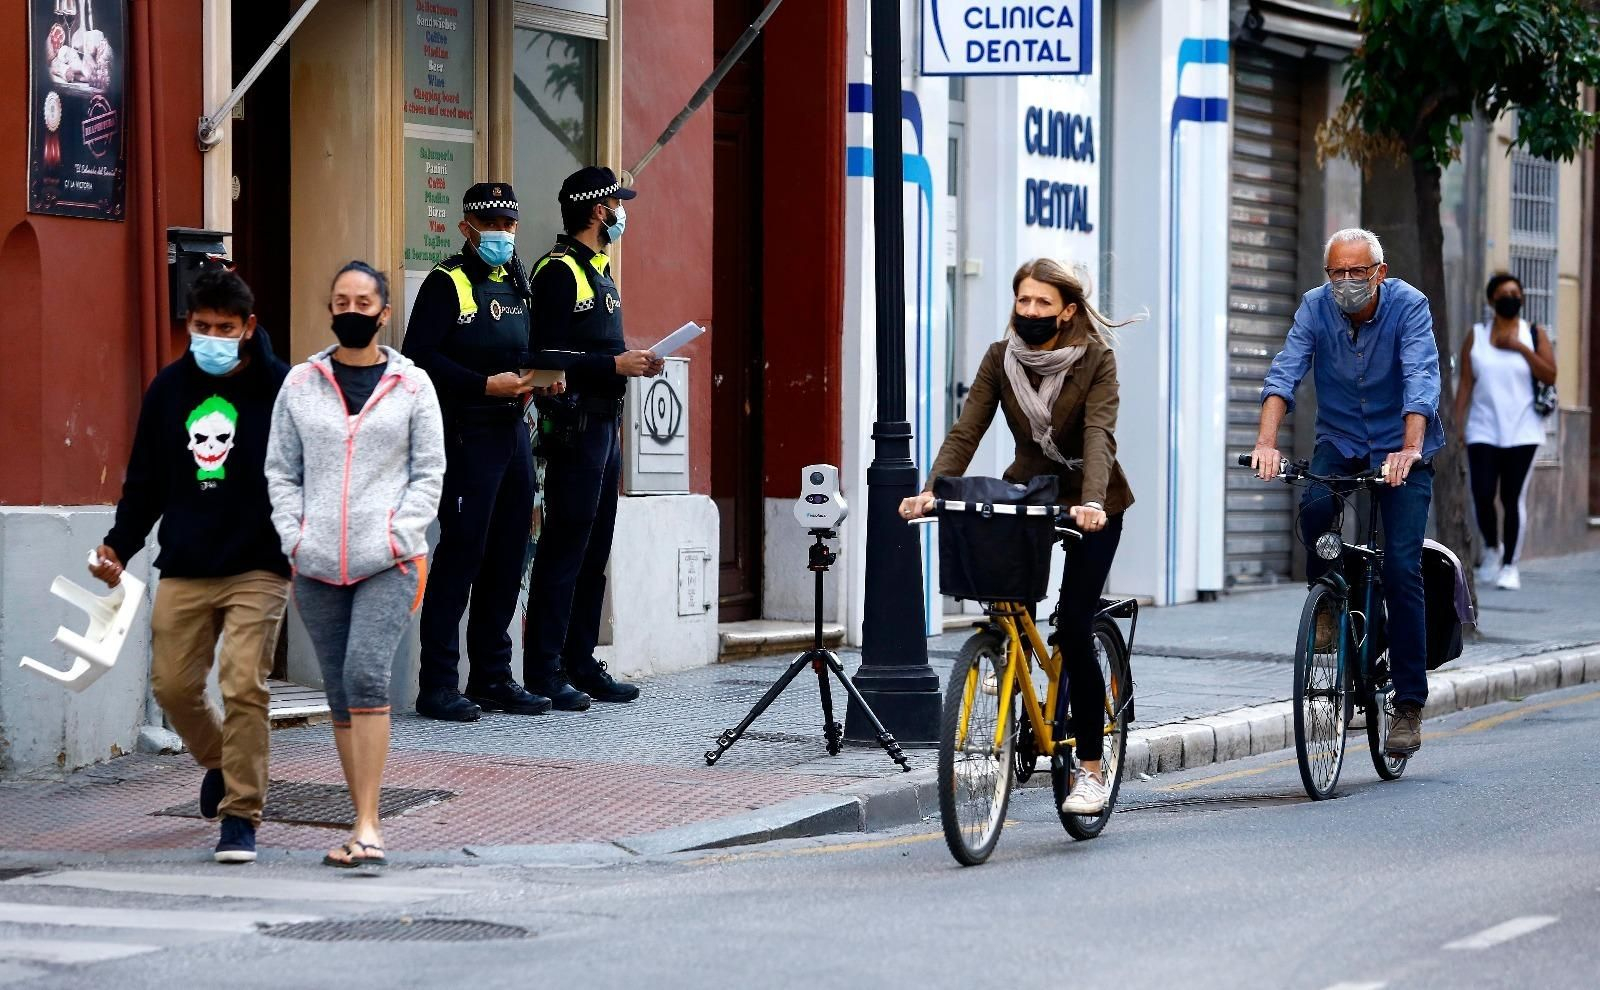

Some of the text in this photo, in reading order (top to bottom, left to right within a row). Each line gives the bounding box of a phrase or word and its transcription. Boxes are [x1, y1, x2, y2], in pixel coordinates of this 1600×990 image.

[416, 14, 457, 31] Sandwiches
[964, 5, 1074, 29] CLINICA
[966, 39, 1071, 62] DENTAL
[428, 59, 444, 73] Beer
[428, 74, 445, 88] Wine
[1024, 105, 1094, 163] CLINICA
[425, 161, 448, 175] Panini
[427, 205, 446, 218] Birra
[1025, 178, 1093, 233] DENTAL
[429, 220, 446, 233] Vino
